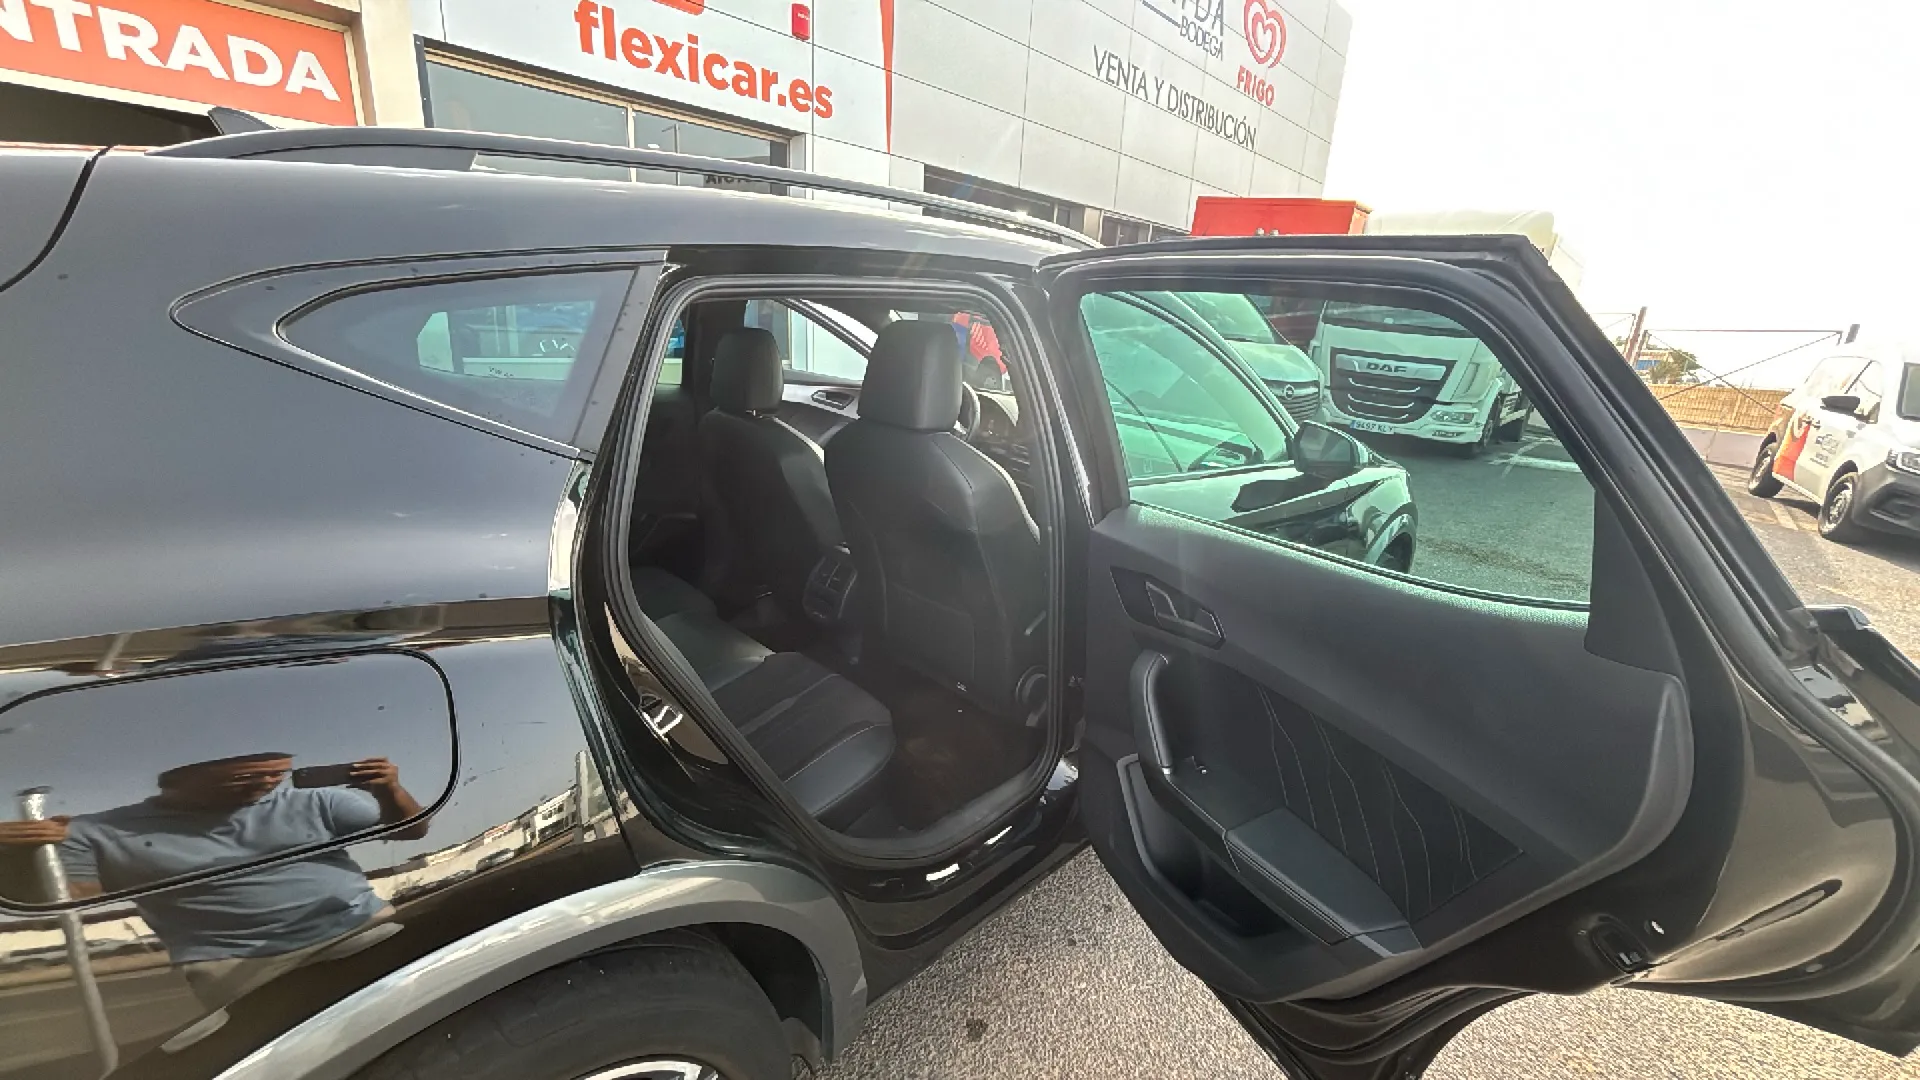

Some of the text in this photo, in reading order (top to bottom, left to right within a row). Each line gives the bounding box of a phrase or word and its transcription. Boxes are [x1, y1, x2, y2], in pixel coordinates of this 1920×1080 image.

[574, 0, 834, 119] flexicar.es
[1180, 15, 1223, 61] BODEGA
[1093, 44, 1257, 151] VENTA Y DISTRIBUCIÓN
[1236, 65, 1275, 107] FRIGO
[1366, 361, 1407, 373] DAF
